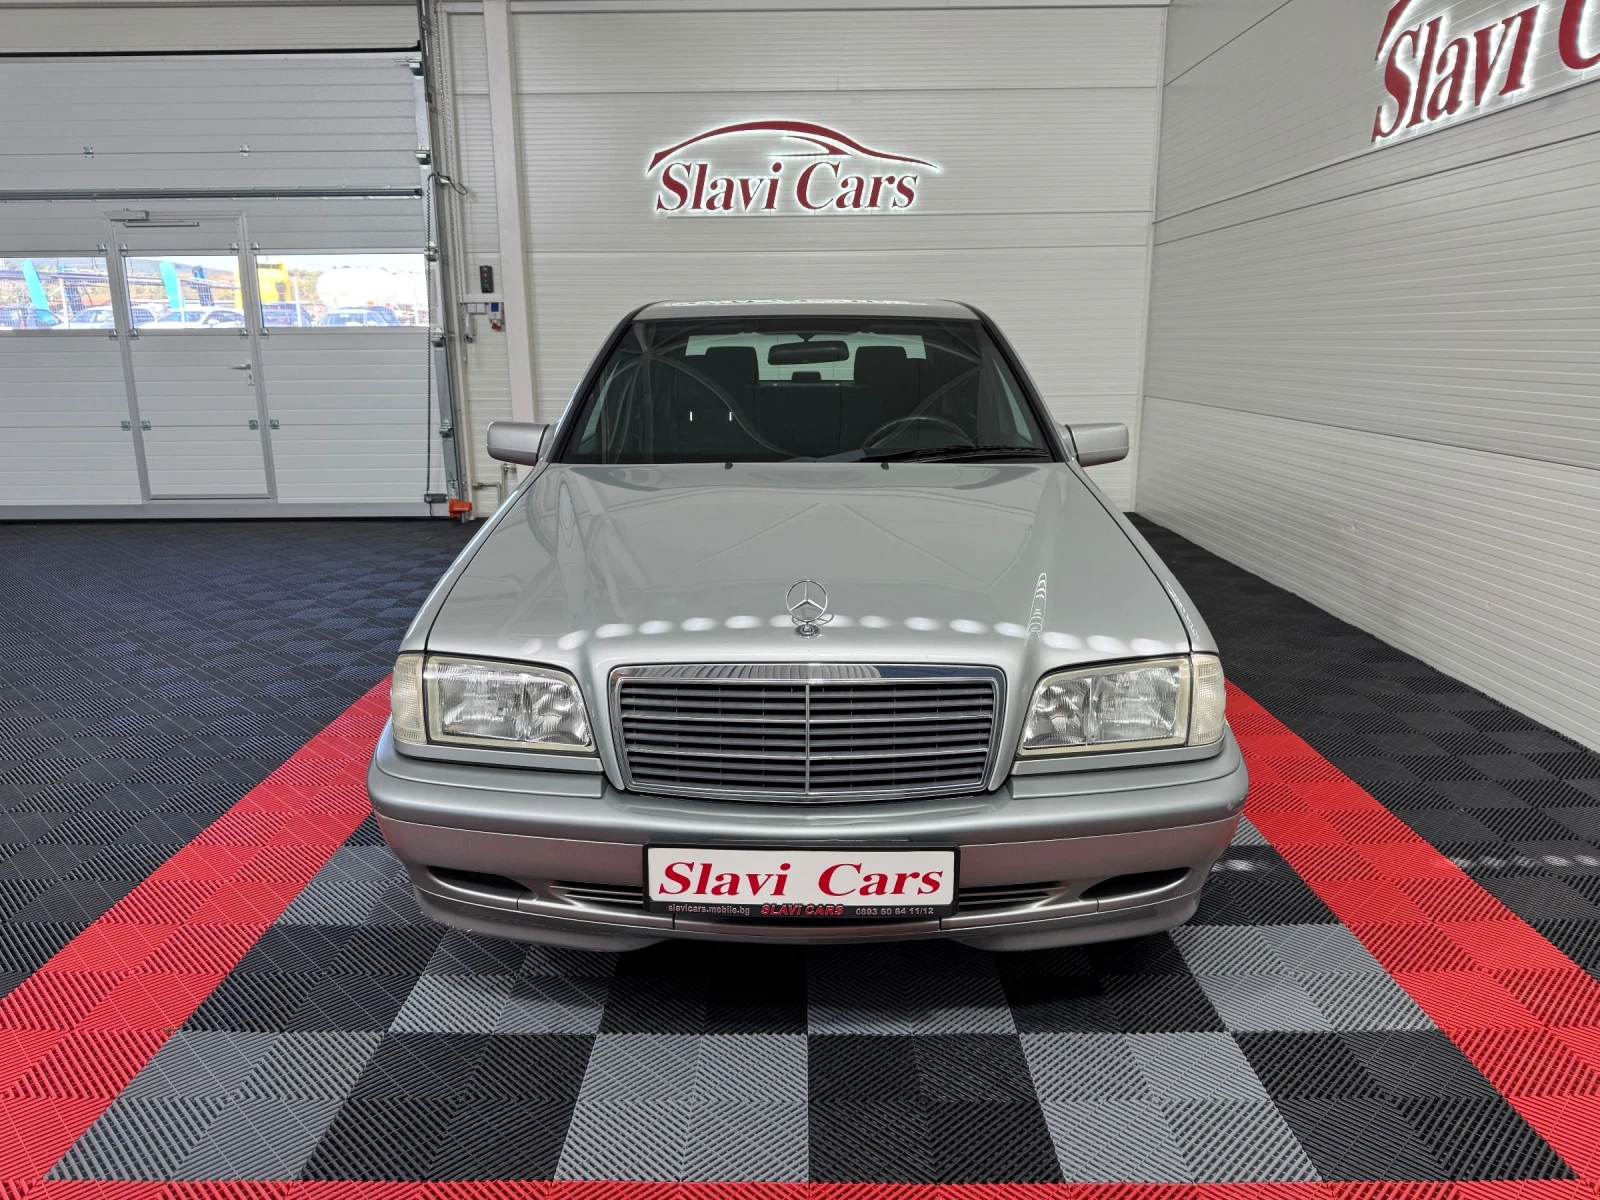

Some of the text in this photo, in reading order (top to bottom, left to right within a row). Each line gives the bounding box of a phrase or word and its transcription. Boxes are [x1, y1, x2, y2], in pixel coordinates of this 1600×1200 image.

[1371, 4, 1541, 143] Slavi
[656, 161, 918, 211] Slavi Cars
[658, 861, 944, 897] Slavi Cars
[668, 903, 750, 916] slavicars.mobile.bg
[761, 904, 844, 916] SLAVI CARS
[855, 907, 934, 916] 0893 60 64 11/12
